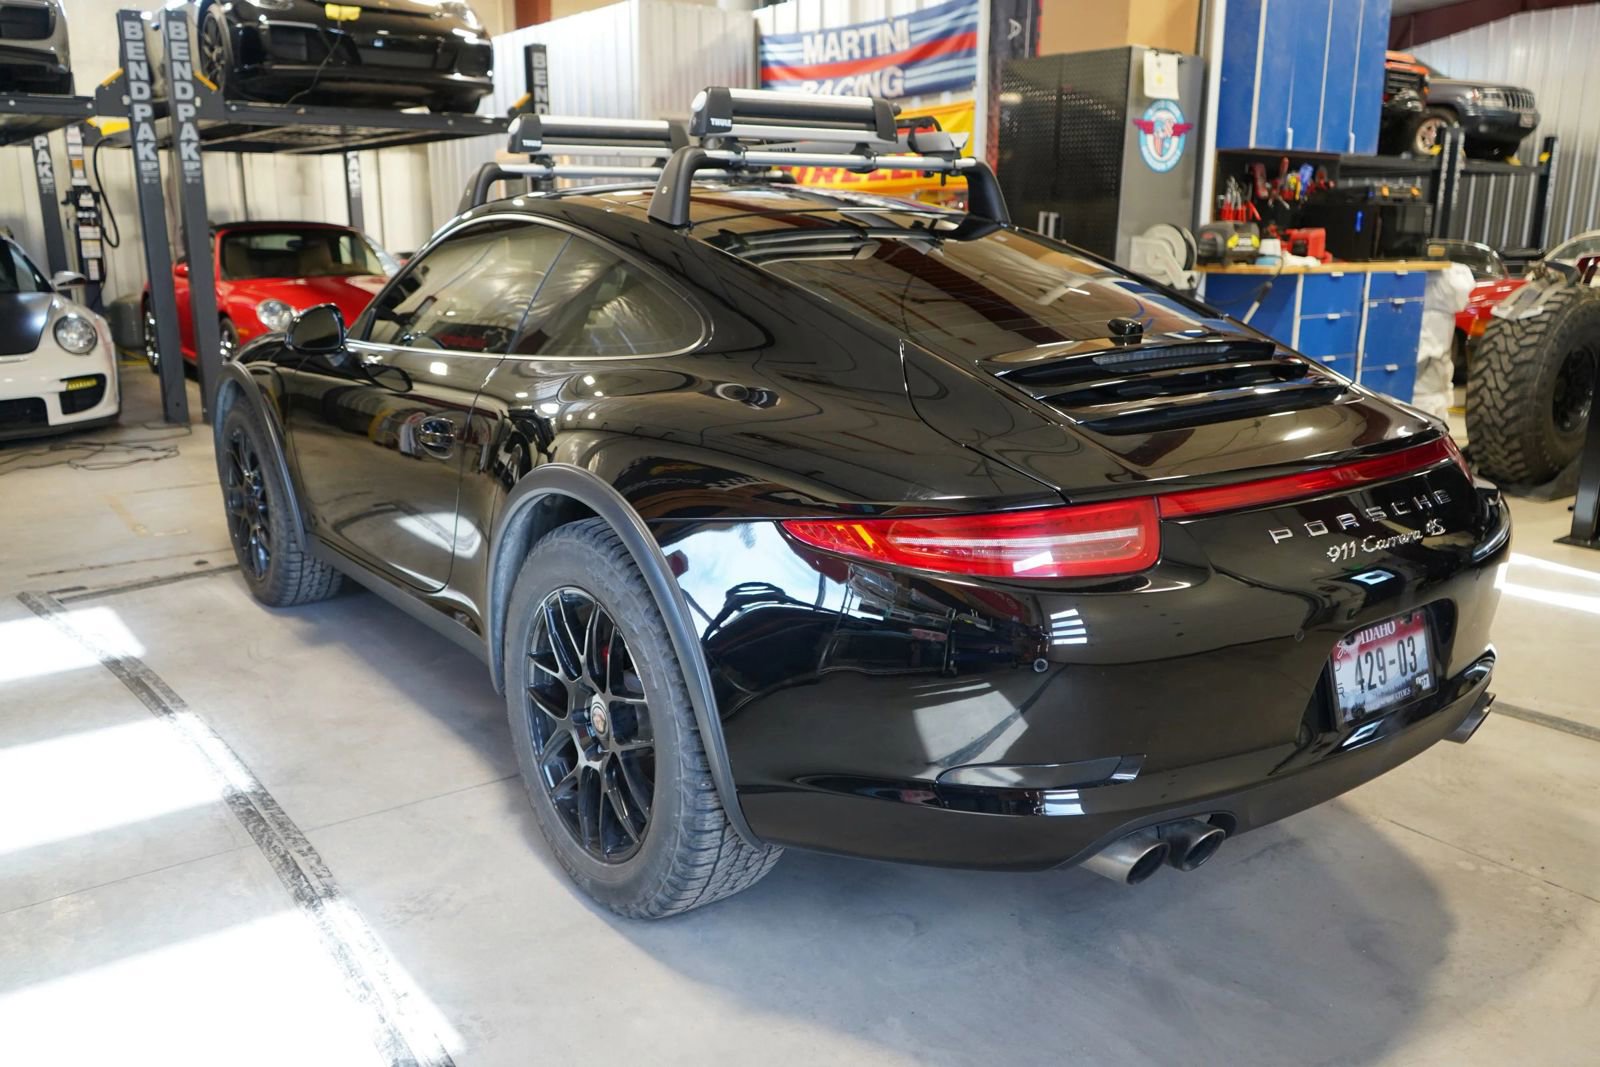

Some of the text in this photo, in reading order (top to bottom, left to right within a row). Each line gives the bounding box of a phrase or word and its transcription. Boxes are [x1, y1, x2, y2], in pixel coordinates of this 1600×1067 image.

[802, 18, 910, 66] MARTINI
[123, 20, 158, 161] BENDPAK
[168, 20, 200, 161] BENDPAK
[1268, 489, 1451, 544] PORSCHE
[1326, 518, 1446, 563] 911 Carrera 4S
[1359, 620, 1397, 645] IDAHO
[1354, 635, 1418, 694] 429-03
